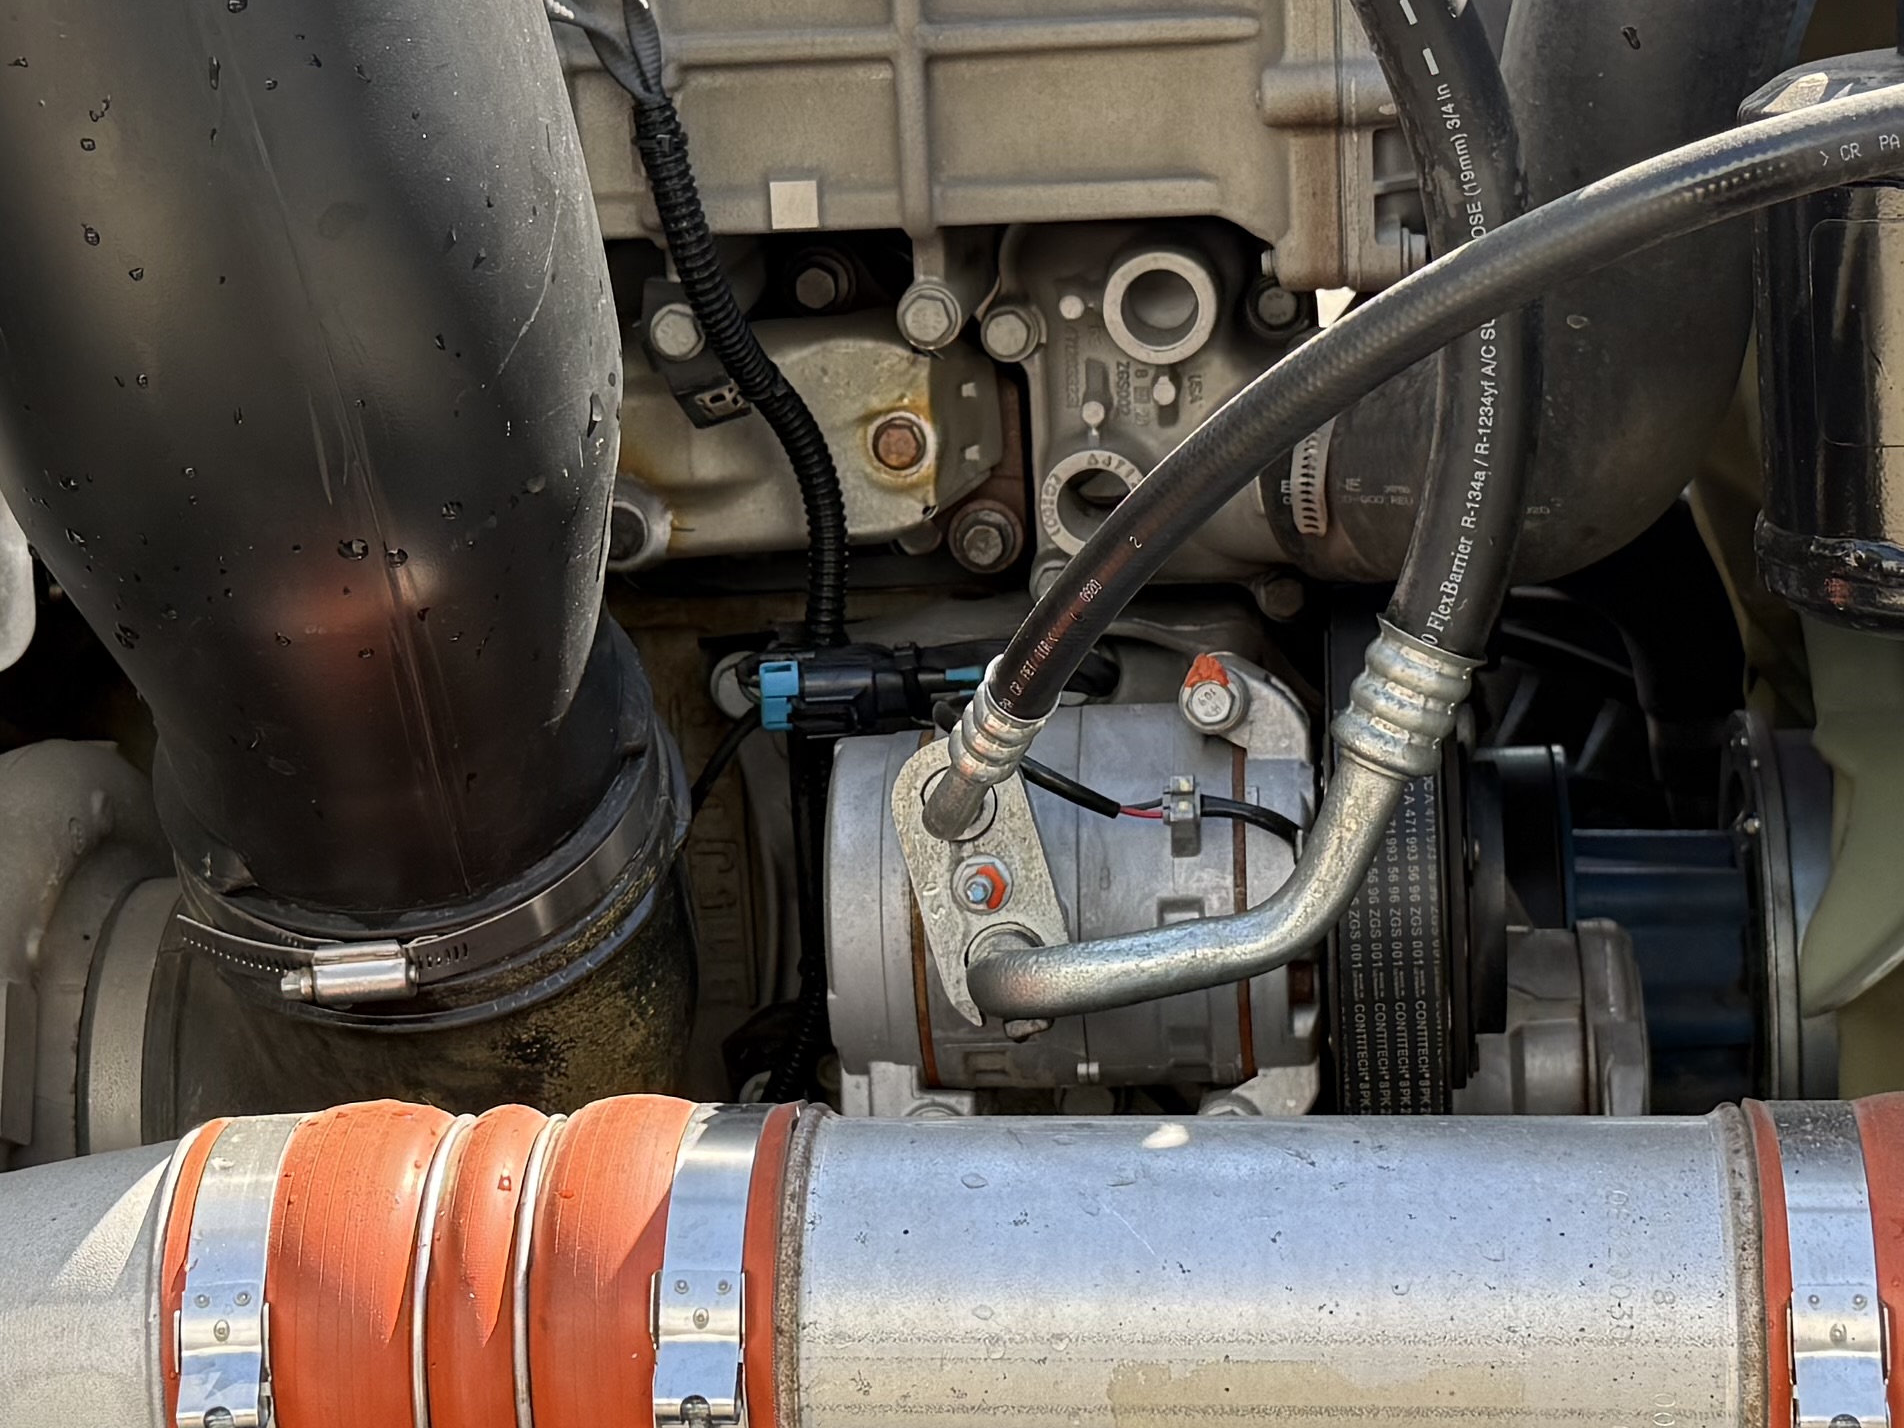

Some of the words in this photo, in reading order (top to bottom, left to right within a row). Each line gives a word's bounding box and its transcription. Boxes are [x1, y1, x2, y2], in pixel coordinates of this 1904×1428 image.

[1442, 102, 1462, 129] 3/4
[1450, 133, 1483, 197] (19mm)
[1840, 144, 1862, 162] CR
[1879, 135, 1901, 152] PA
[1466, 202, 1488, 239] OSE
[1480, 344, 1497, 376] A/C
[1188, 373, 1203, 405] USA
[1475, 380, 1498, 455] R-1234yf
[1461, 470, 1486, 529] R-134a
[1426, 536, 1473, 633] FlexBarrier
[1409, 906, 1423, 936] ZGS
